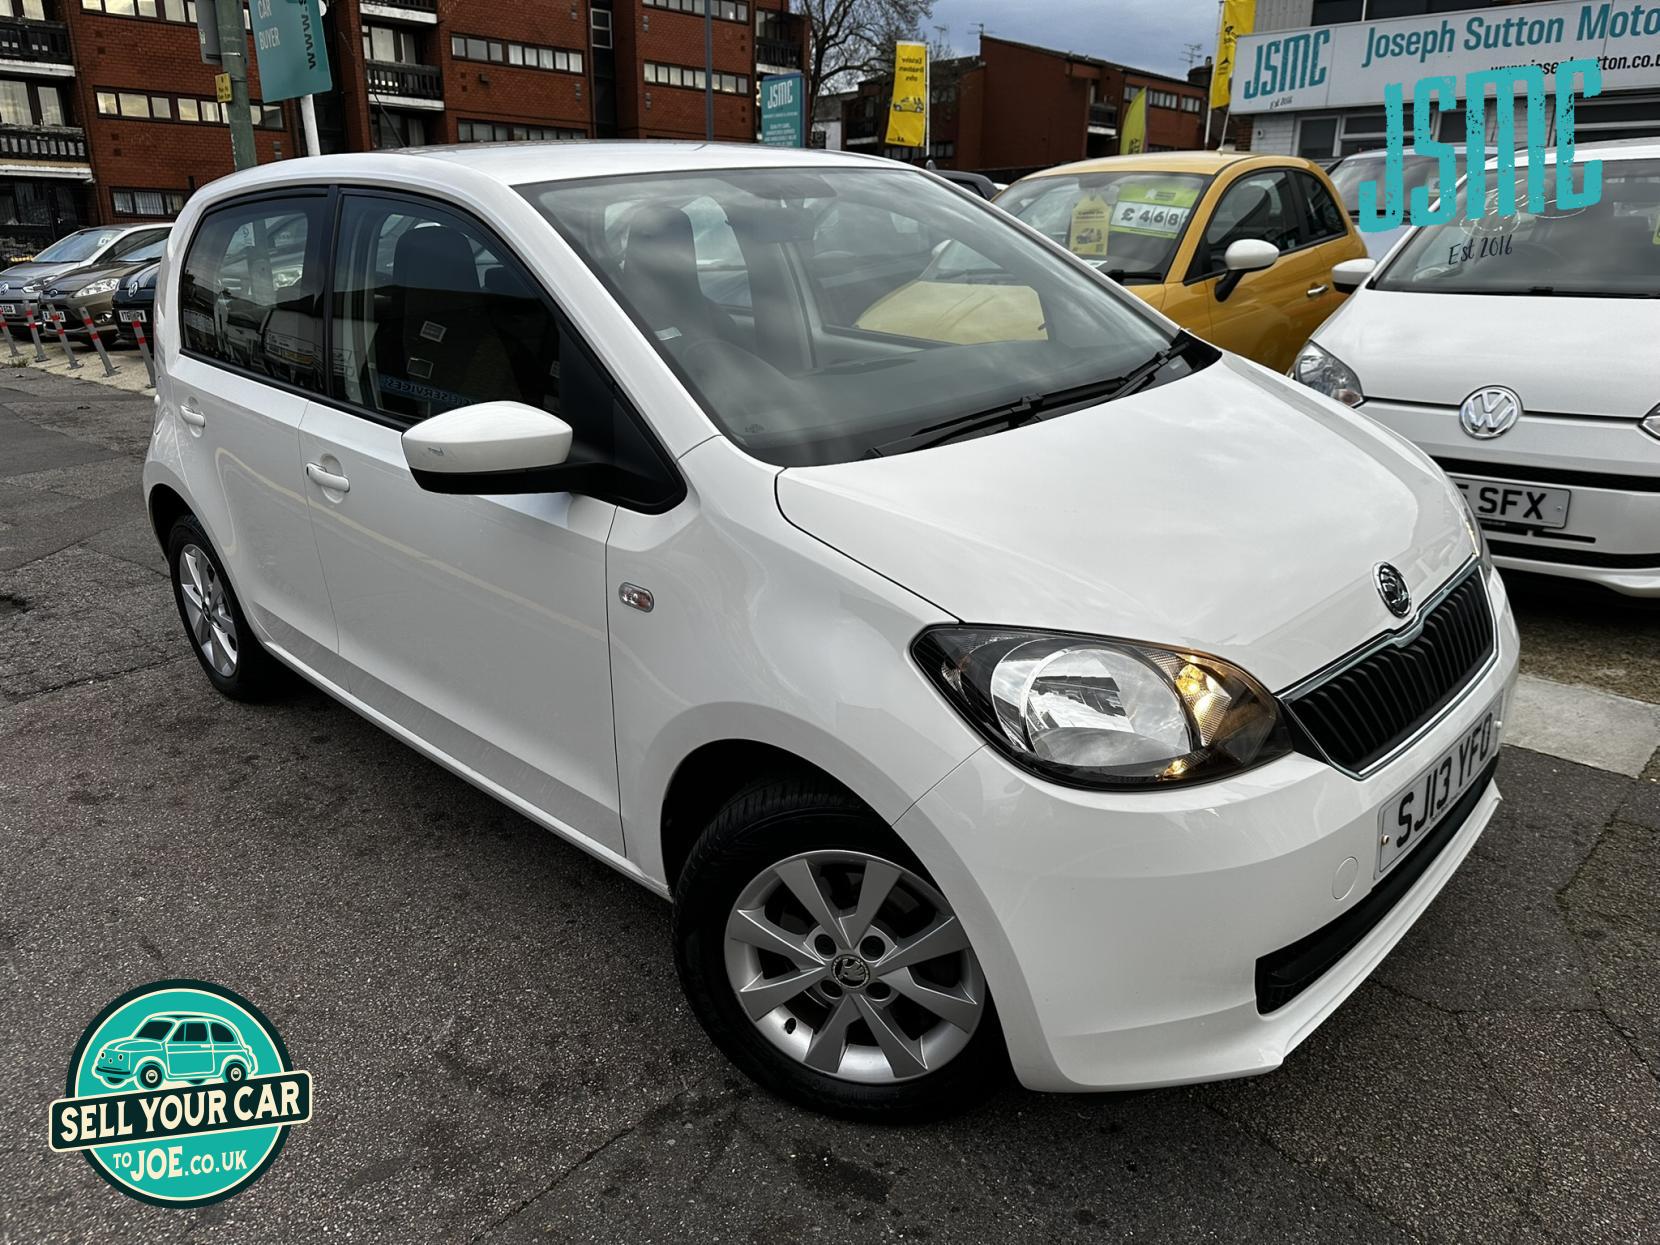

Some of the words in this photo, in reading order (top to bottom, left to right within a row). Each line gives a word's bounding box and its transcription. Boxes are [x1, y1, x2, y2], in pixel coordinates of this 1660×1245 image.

[259, 27, 280, 50] BUYER
[1361, 20, 1456, 68] Joseph
[1464, 16, 1565, 51] Sutton
[1243, 29, 1330, 99] JSMC
[768, 80, 793, 109] JSMC
[1478, 486, 1547, 520] SFX
[1396, 756, 1453, 848] SJ13
